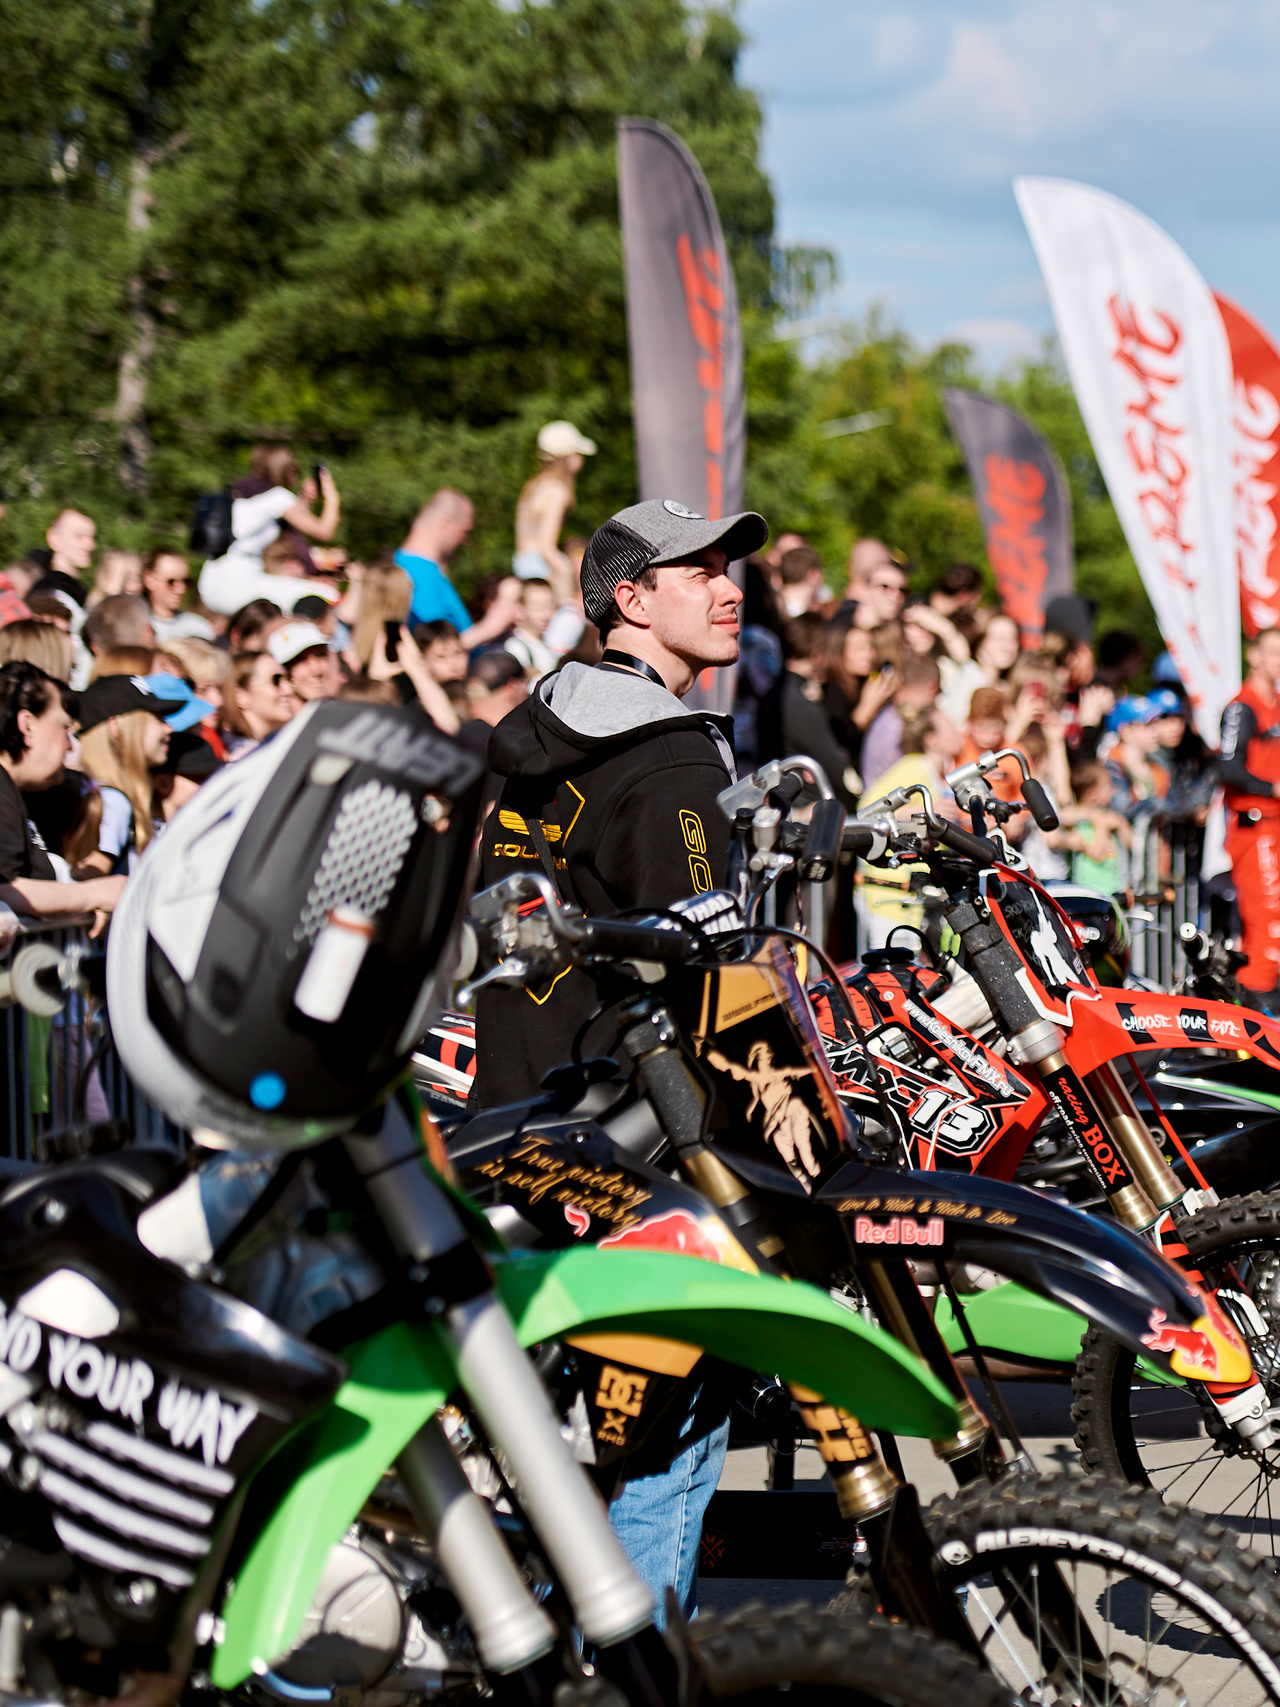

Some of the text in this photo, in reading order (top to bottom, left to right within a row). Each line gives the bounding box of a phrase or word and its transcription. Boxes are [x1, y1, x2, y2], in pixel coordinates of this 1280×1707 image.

[901, 999, 1015, 1098] www.KolesnikovFMX.ru
[1121, 1014, 1240, 1038] CHOOSE YOUR FATE
[910, 1089, 988, 1146] 13
[1049, 1090, 1107, 1189] off-road racing suspensions
[1058, 1077, 1126, 1184] racing BOX
[474, 1157, 643, 1236] is self victory
[509, 1134, 653, 1215] True victory
[855, 1216, 944, 1246] Red Bull
[48, 1333, 154, 1425] YOUR
[158, 1373, 259, 1469] WAY
[975, 1528, 1088, 1553] ALEXEY
